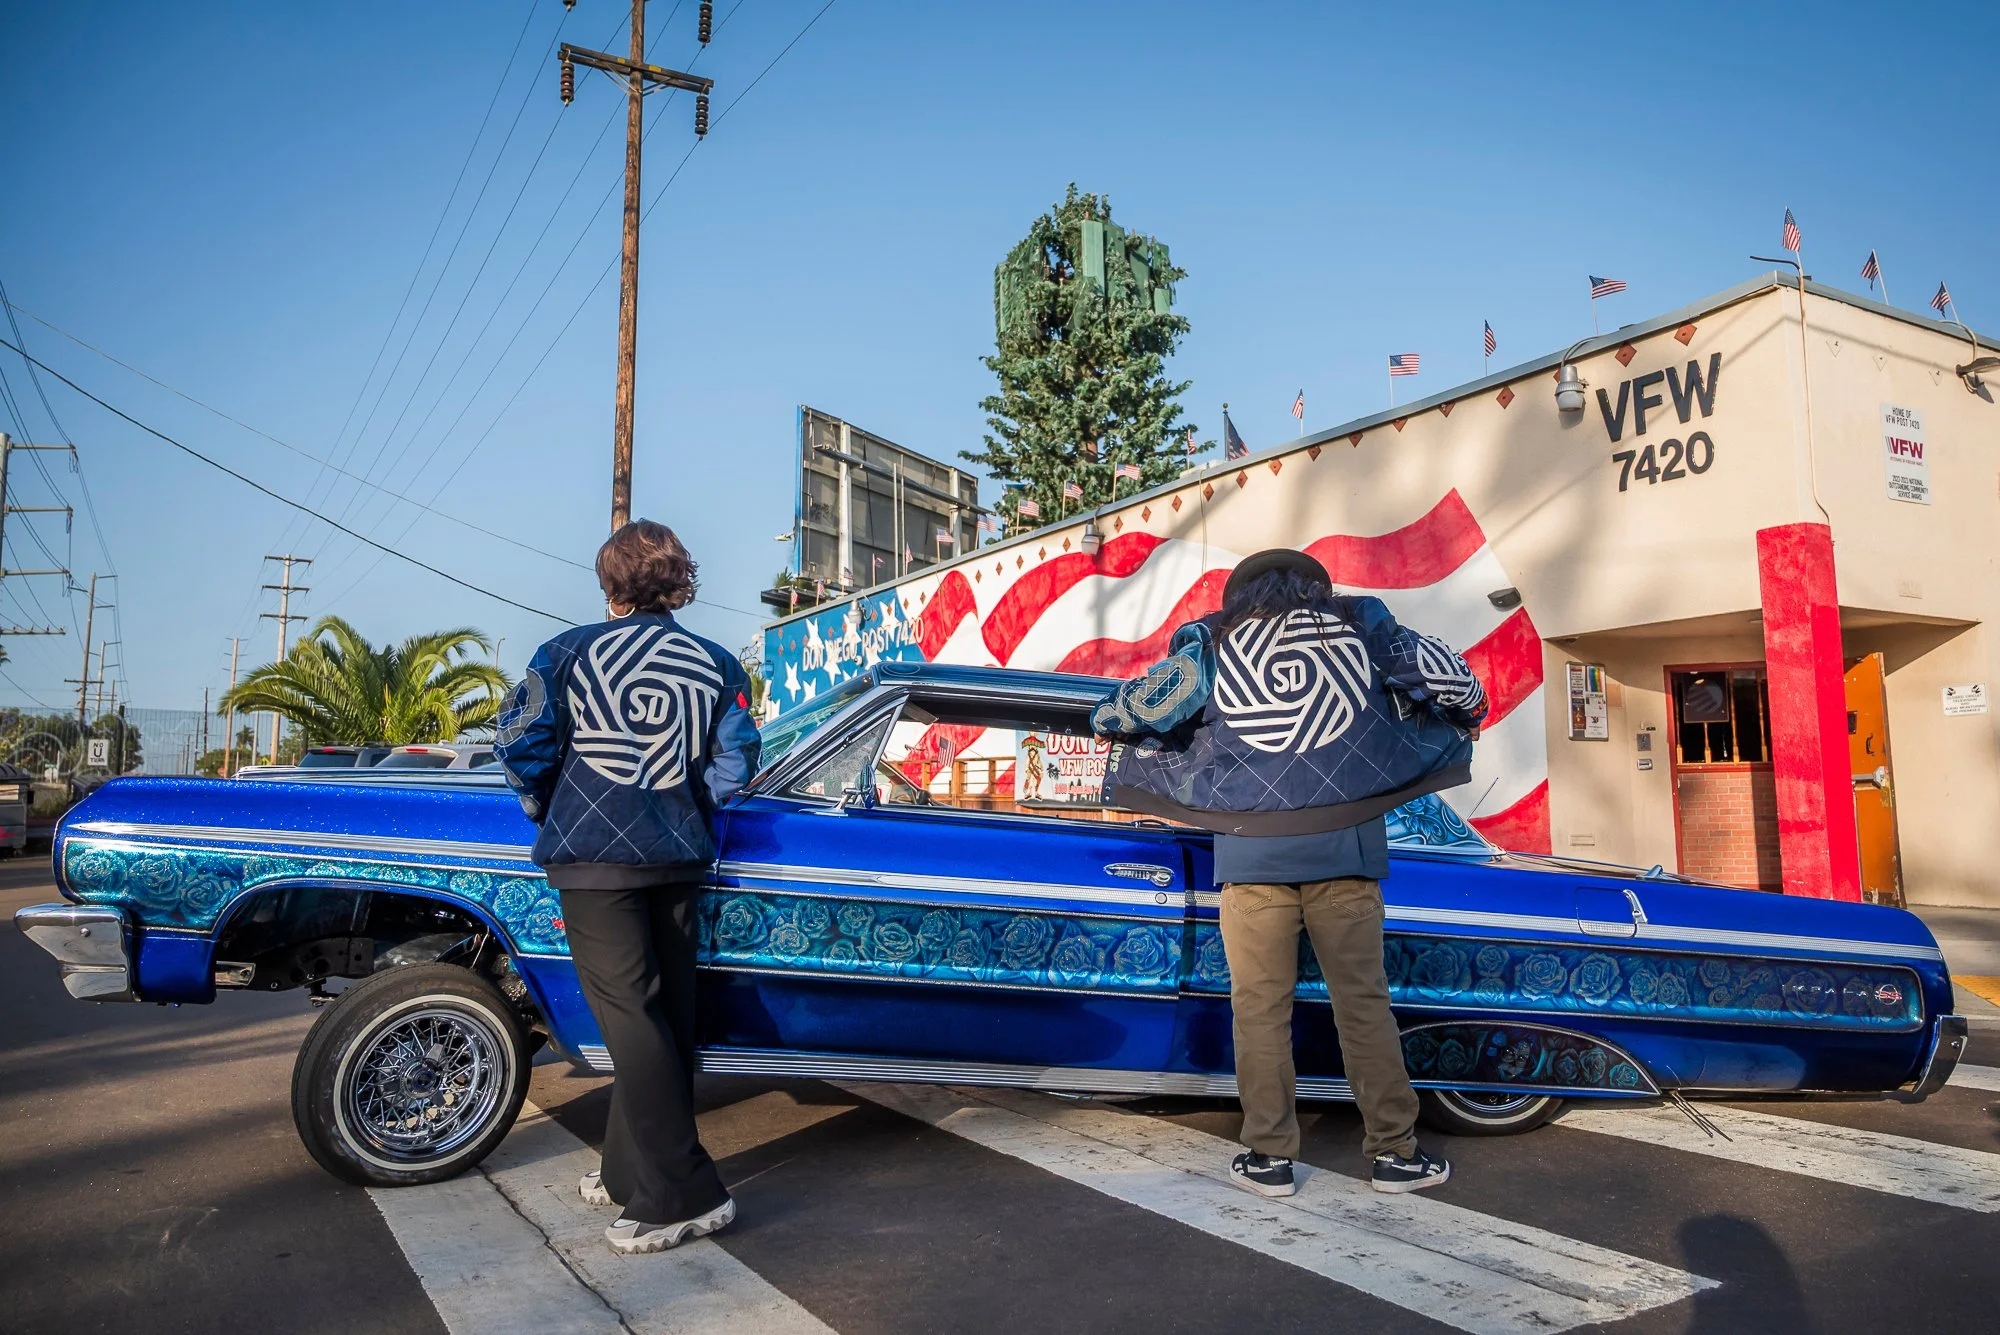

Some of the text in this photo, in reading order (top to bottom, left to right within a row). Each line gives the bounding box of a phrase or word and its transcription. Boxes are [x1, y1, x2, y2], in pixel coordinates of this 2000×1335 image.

[1595, 352, 1722, 443] VFW
[1612, 431, 1715, 493] 7420
[1890, 437, 1923, 459] VFW
[862, 625, 890, 656] POST
[896, 616, 925, 648] 7420
[1271, 658, 1307, 694] SD
[628, 686, 671, 726] SD
[93, 747, 103, 758] U
[1059, 757, 1107, 776] VFW POS
